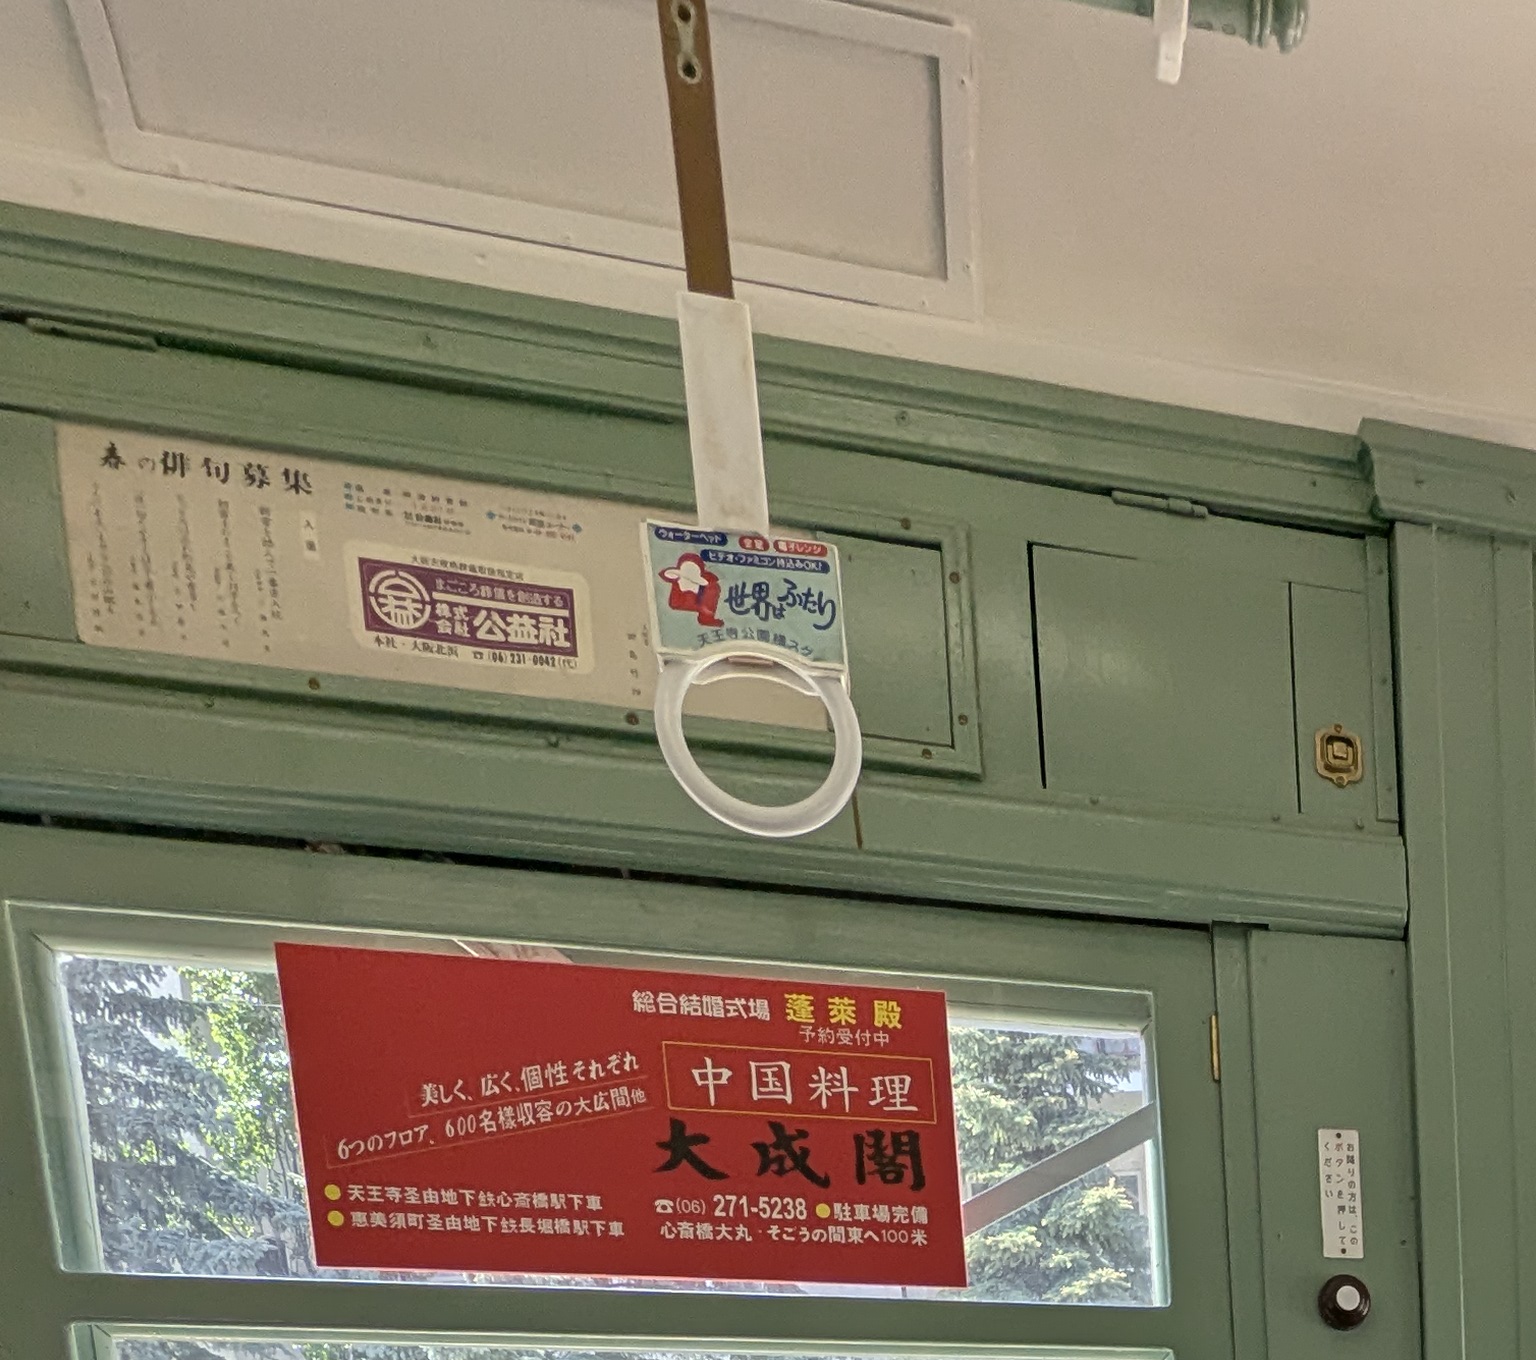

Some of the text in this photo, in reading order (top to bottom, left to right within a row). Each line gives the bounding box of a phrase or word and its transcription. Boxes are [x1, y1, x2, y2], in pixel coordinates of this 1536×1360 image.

[100, 440, 313, 495] 春の俳句募集
[473, 609, 572, 648] 公益社
[723, 577, 837, 631] 世界はふたり
[632, 989, 771, 1021] 総合結婚式場
[799, 1025, 890, 1047] 予約受付中
[691, 1056, 920, 1113] 中国料理
[653, 1117, 926, 1191] 大成閣
[1323, 1141, 1334, 1199] ください
[675, 1194, 929, 1225] (06) 271-5238 駐車場完備
[1334, 1142, 1347, 1246] ボタンを押して
